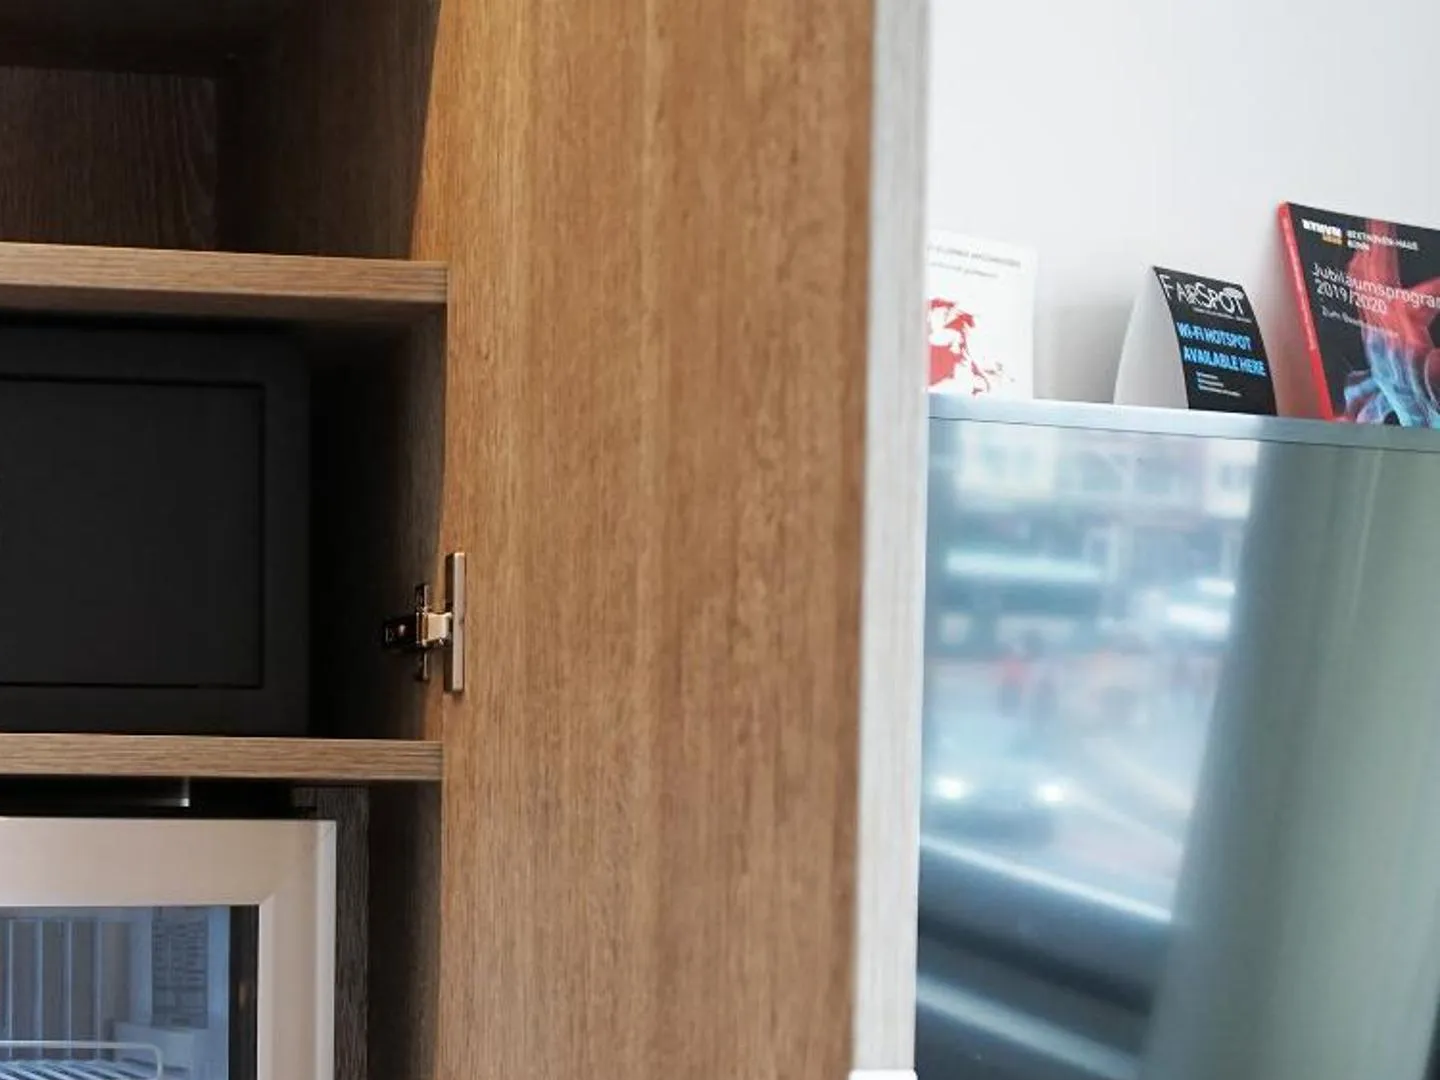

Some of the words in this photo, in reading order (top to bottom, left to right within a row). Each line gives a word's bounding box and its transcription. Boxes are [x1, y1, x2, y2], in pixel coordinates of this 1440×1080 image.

[1314, 278, 1388, 314] 2019/2020
[1203, 327, 1252, 351] HOTSPOT
[1182, 345, 1239, 371] AVAILABLE
[1238, 356, 1267, 377] HERE
